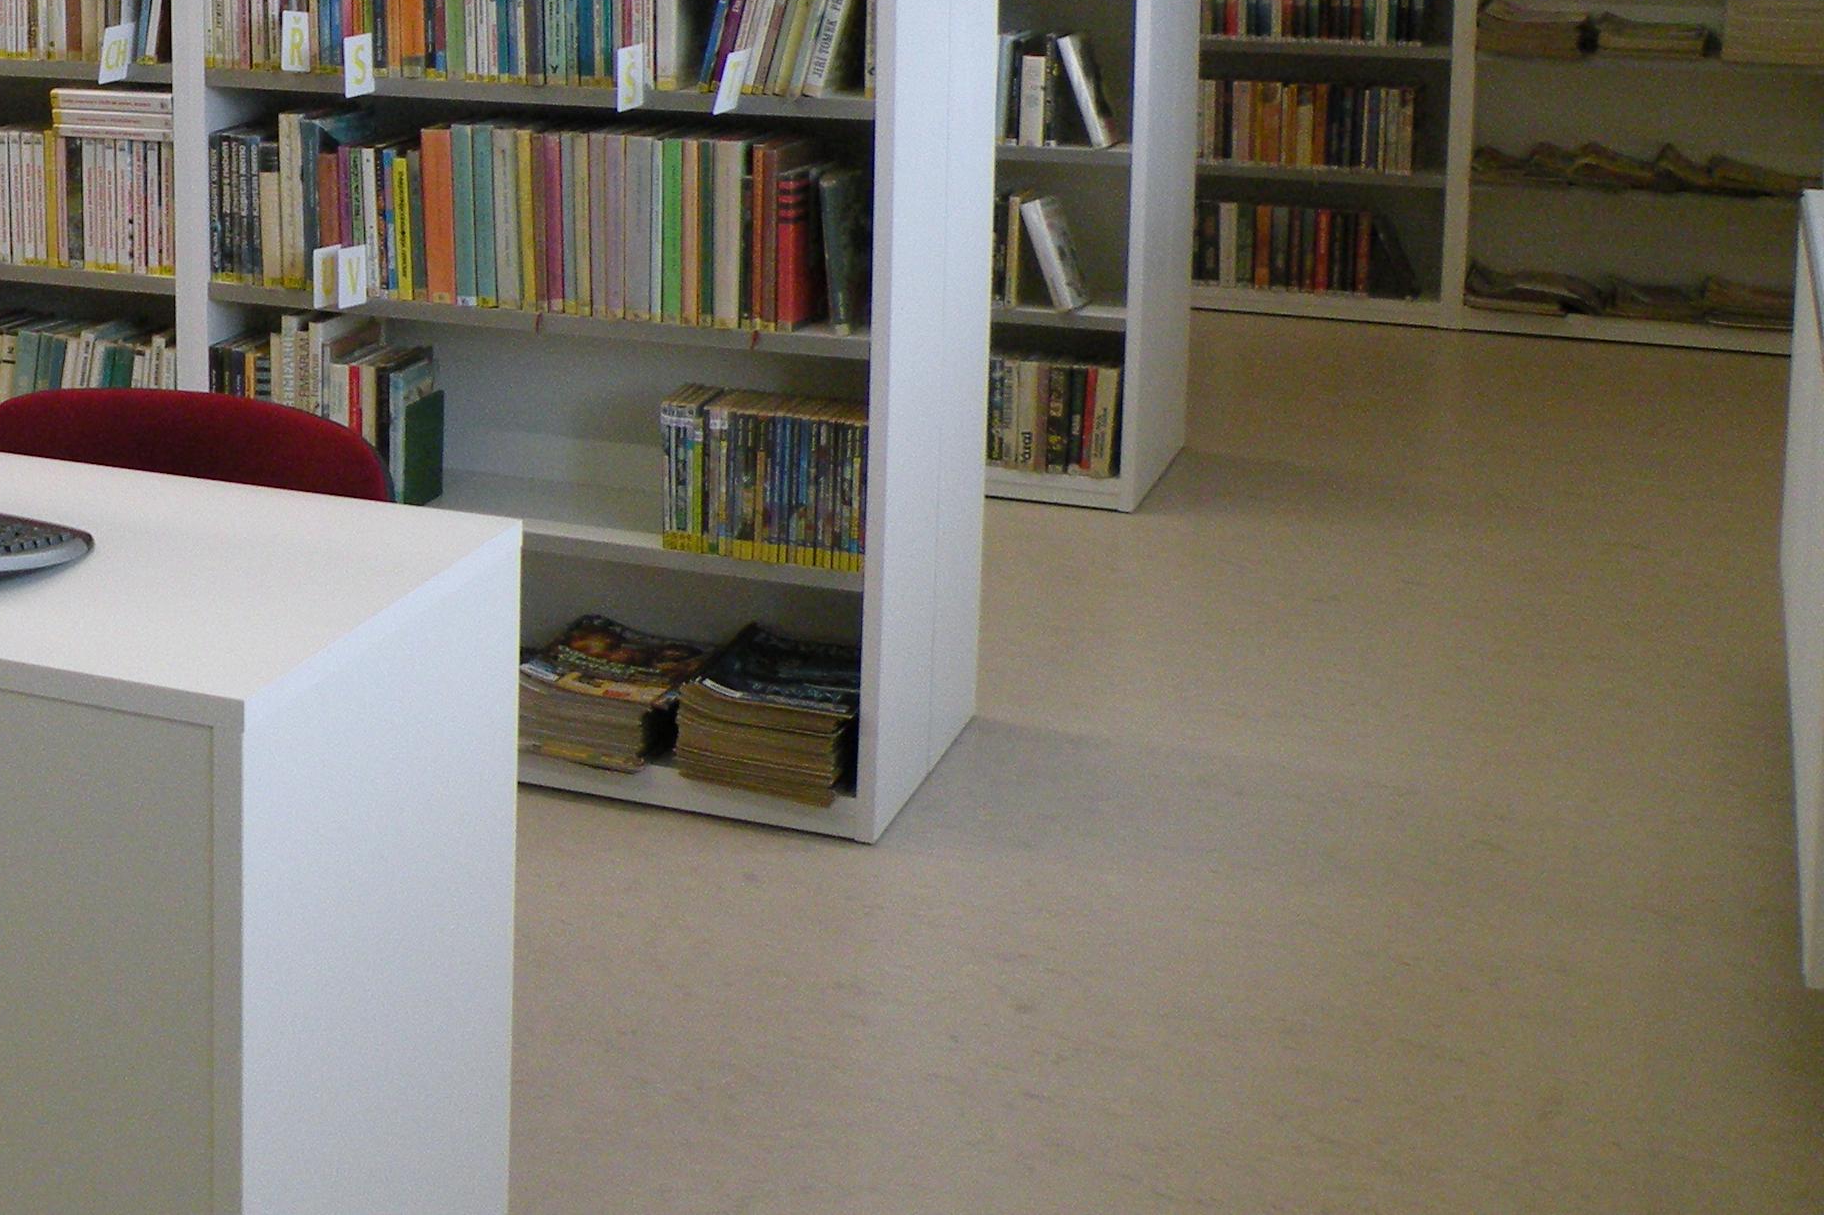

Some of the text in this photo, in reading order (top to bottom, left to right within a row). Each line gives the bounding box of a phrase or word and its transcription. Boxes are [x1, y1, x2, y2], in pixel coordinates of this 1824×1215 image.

[104, 39, 128, 70] CH
[289, 15, 305, 67] Ř
[351, 44, 367, 86] S
[346, 257, 360, 296] V
